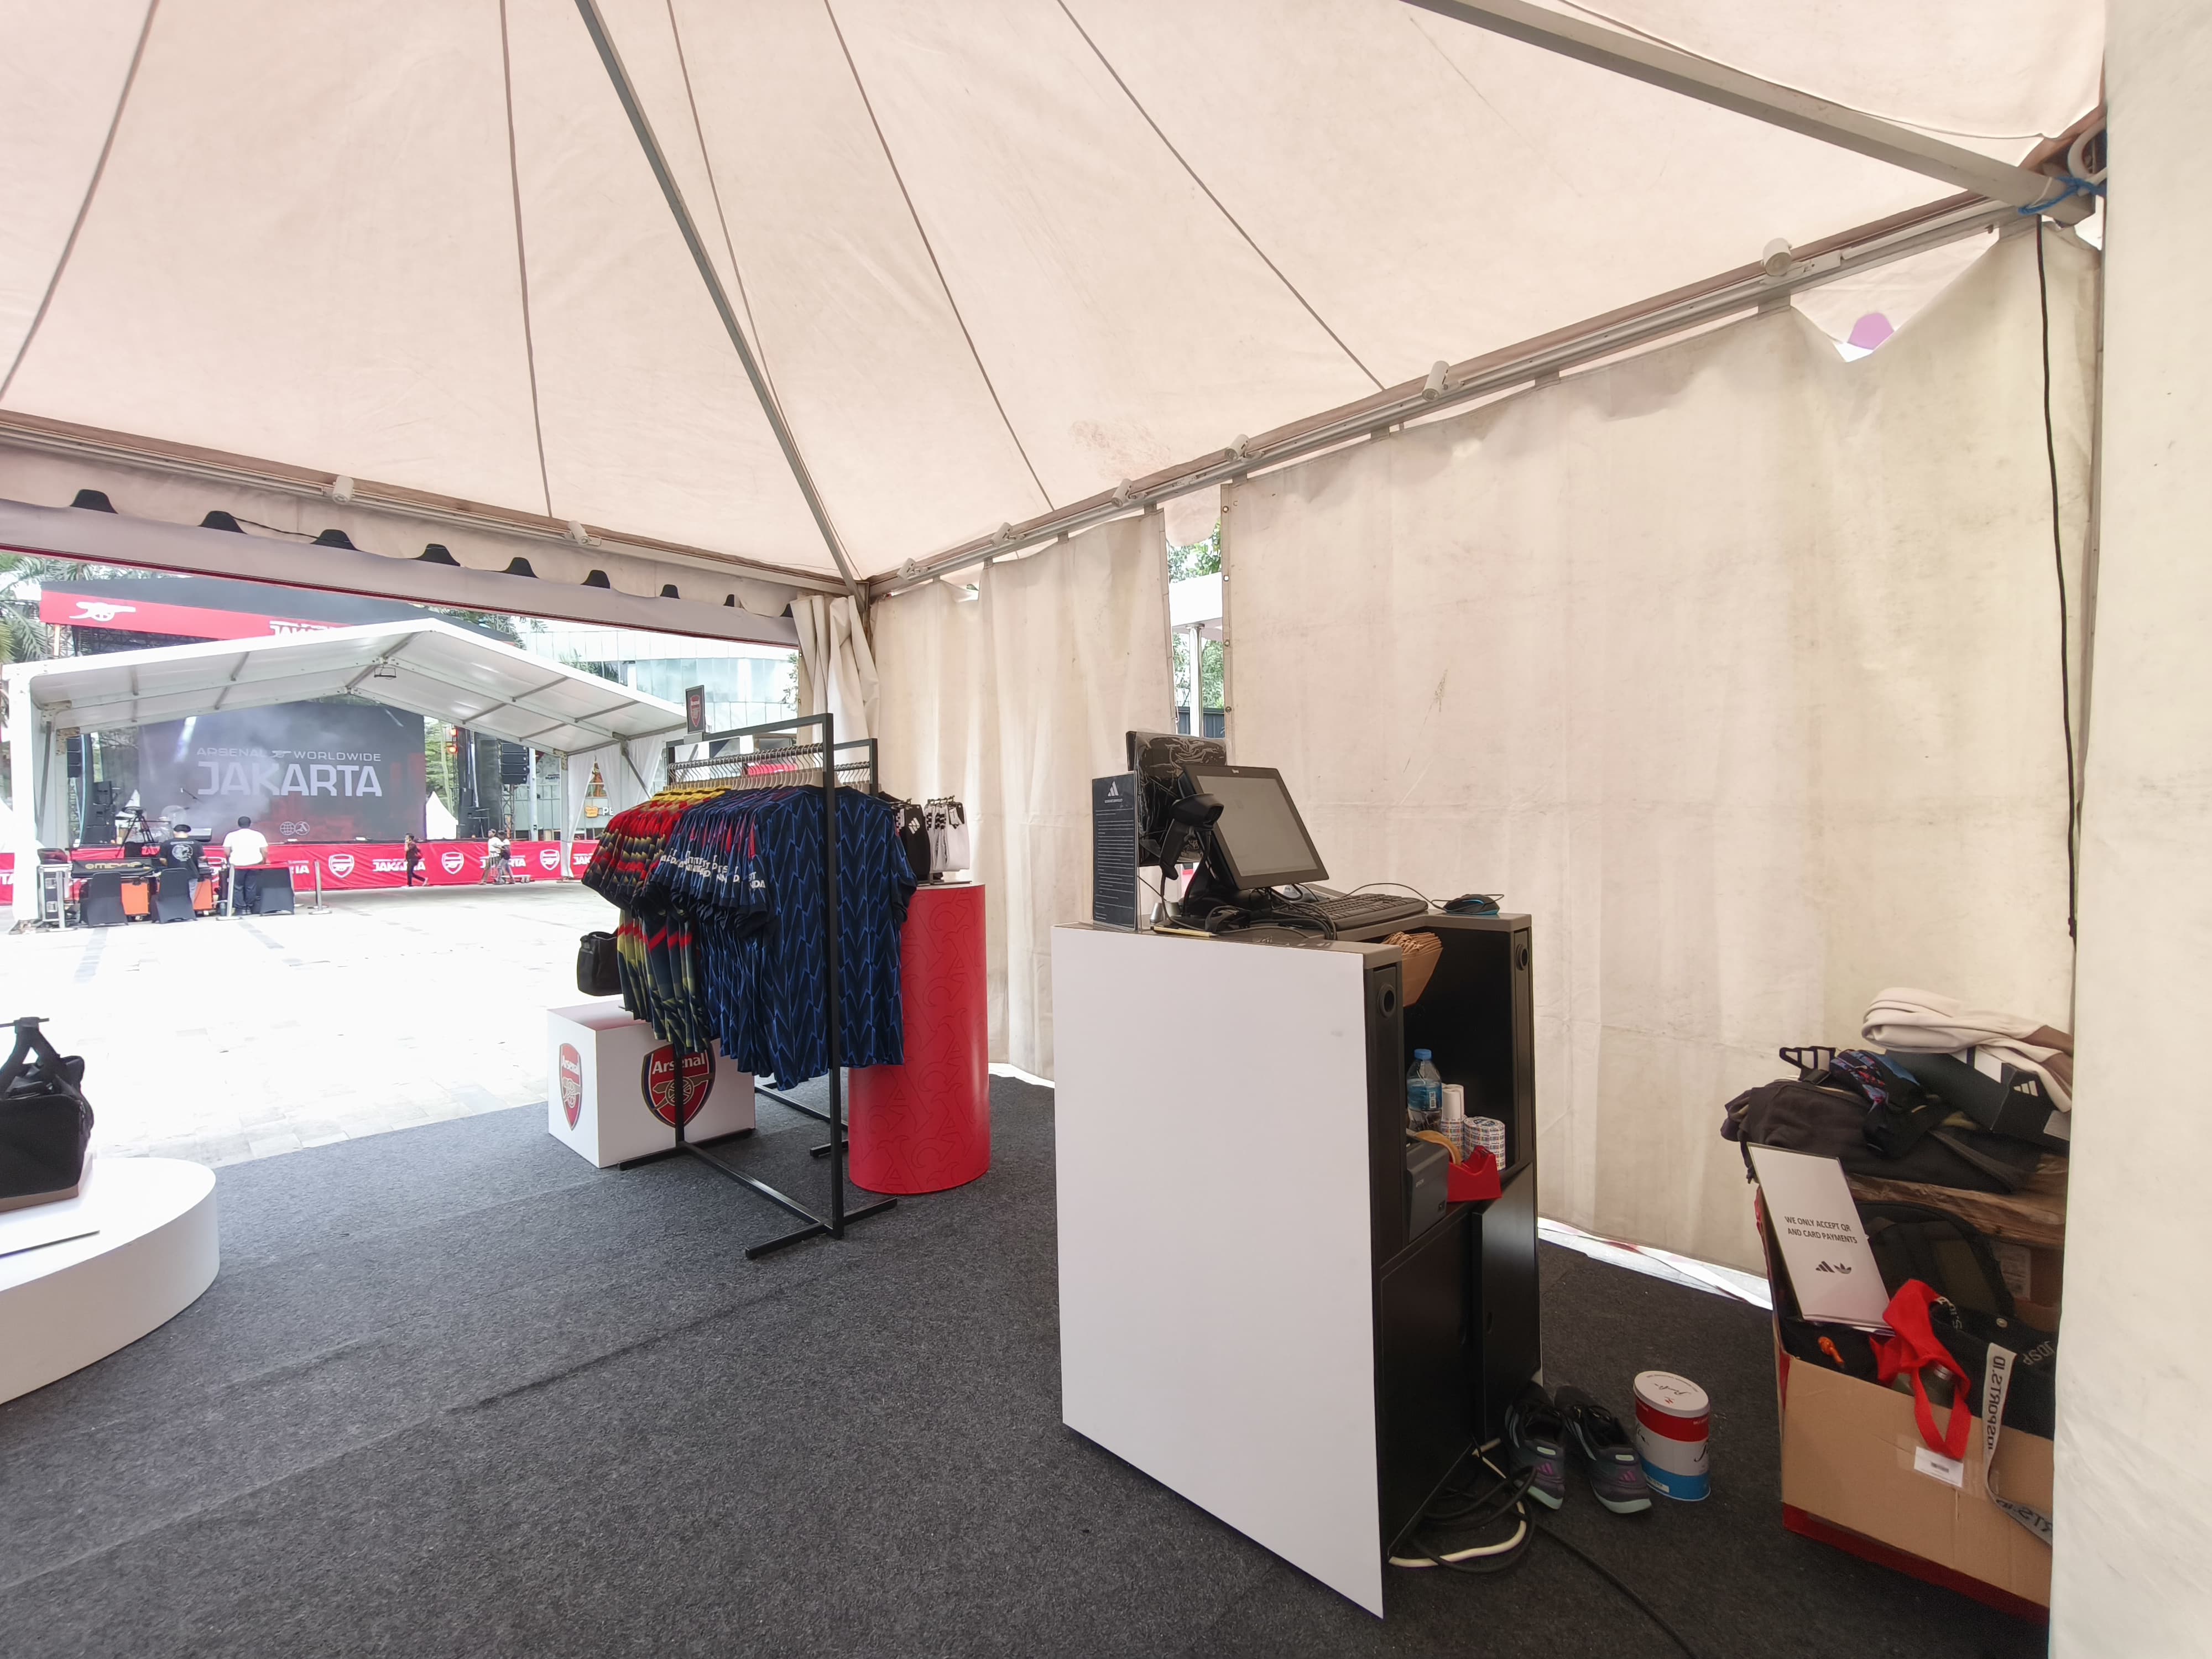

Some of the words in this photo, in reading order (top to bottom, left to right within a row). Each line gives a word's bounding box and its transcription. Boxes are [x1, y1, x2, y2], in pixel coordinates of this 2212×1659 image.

[197, 748, 267, 758] ARSENAL
[294, 751, 381, 761] WORLDWIDE
[197, 761, 382, 796] JAKARTA
[1797, 1218, 1814, 1227] ONLY
[1816, 1220, 1840, 1230] ACCEPT
[1840, 1224, 1851, 1232] QR
[1788, 1228, 1802, 1237] AND
[1803, 1230, 1822, 1239] CARD
[1822, 1233, 1858, 1244] PAYMENTS
